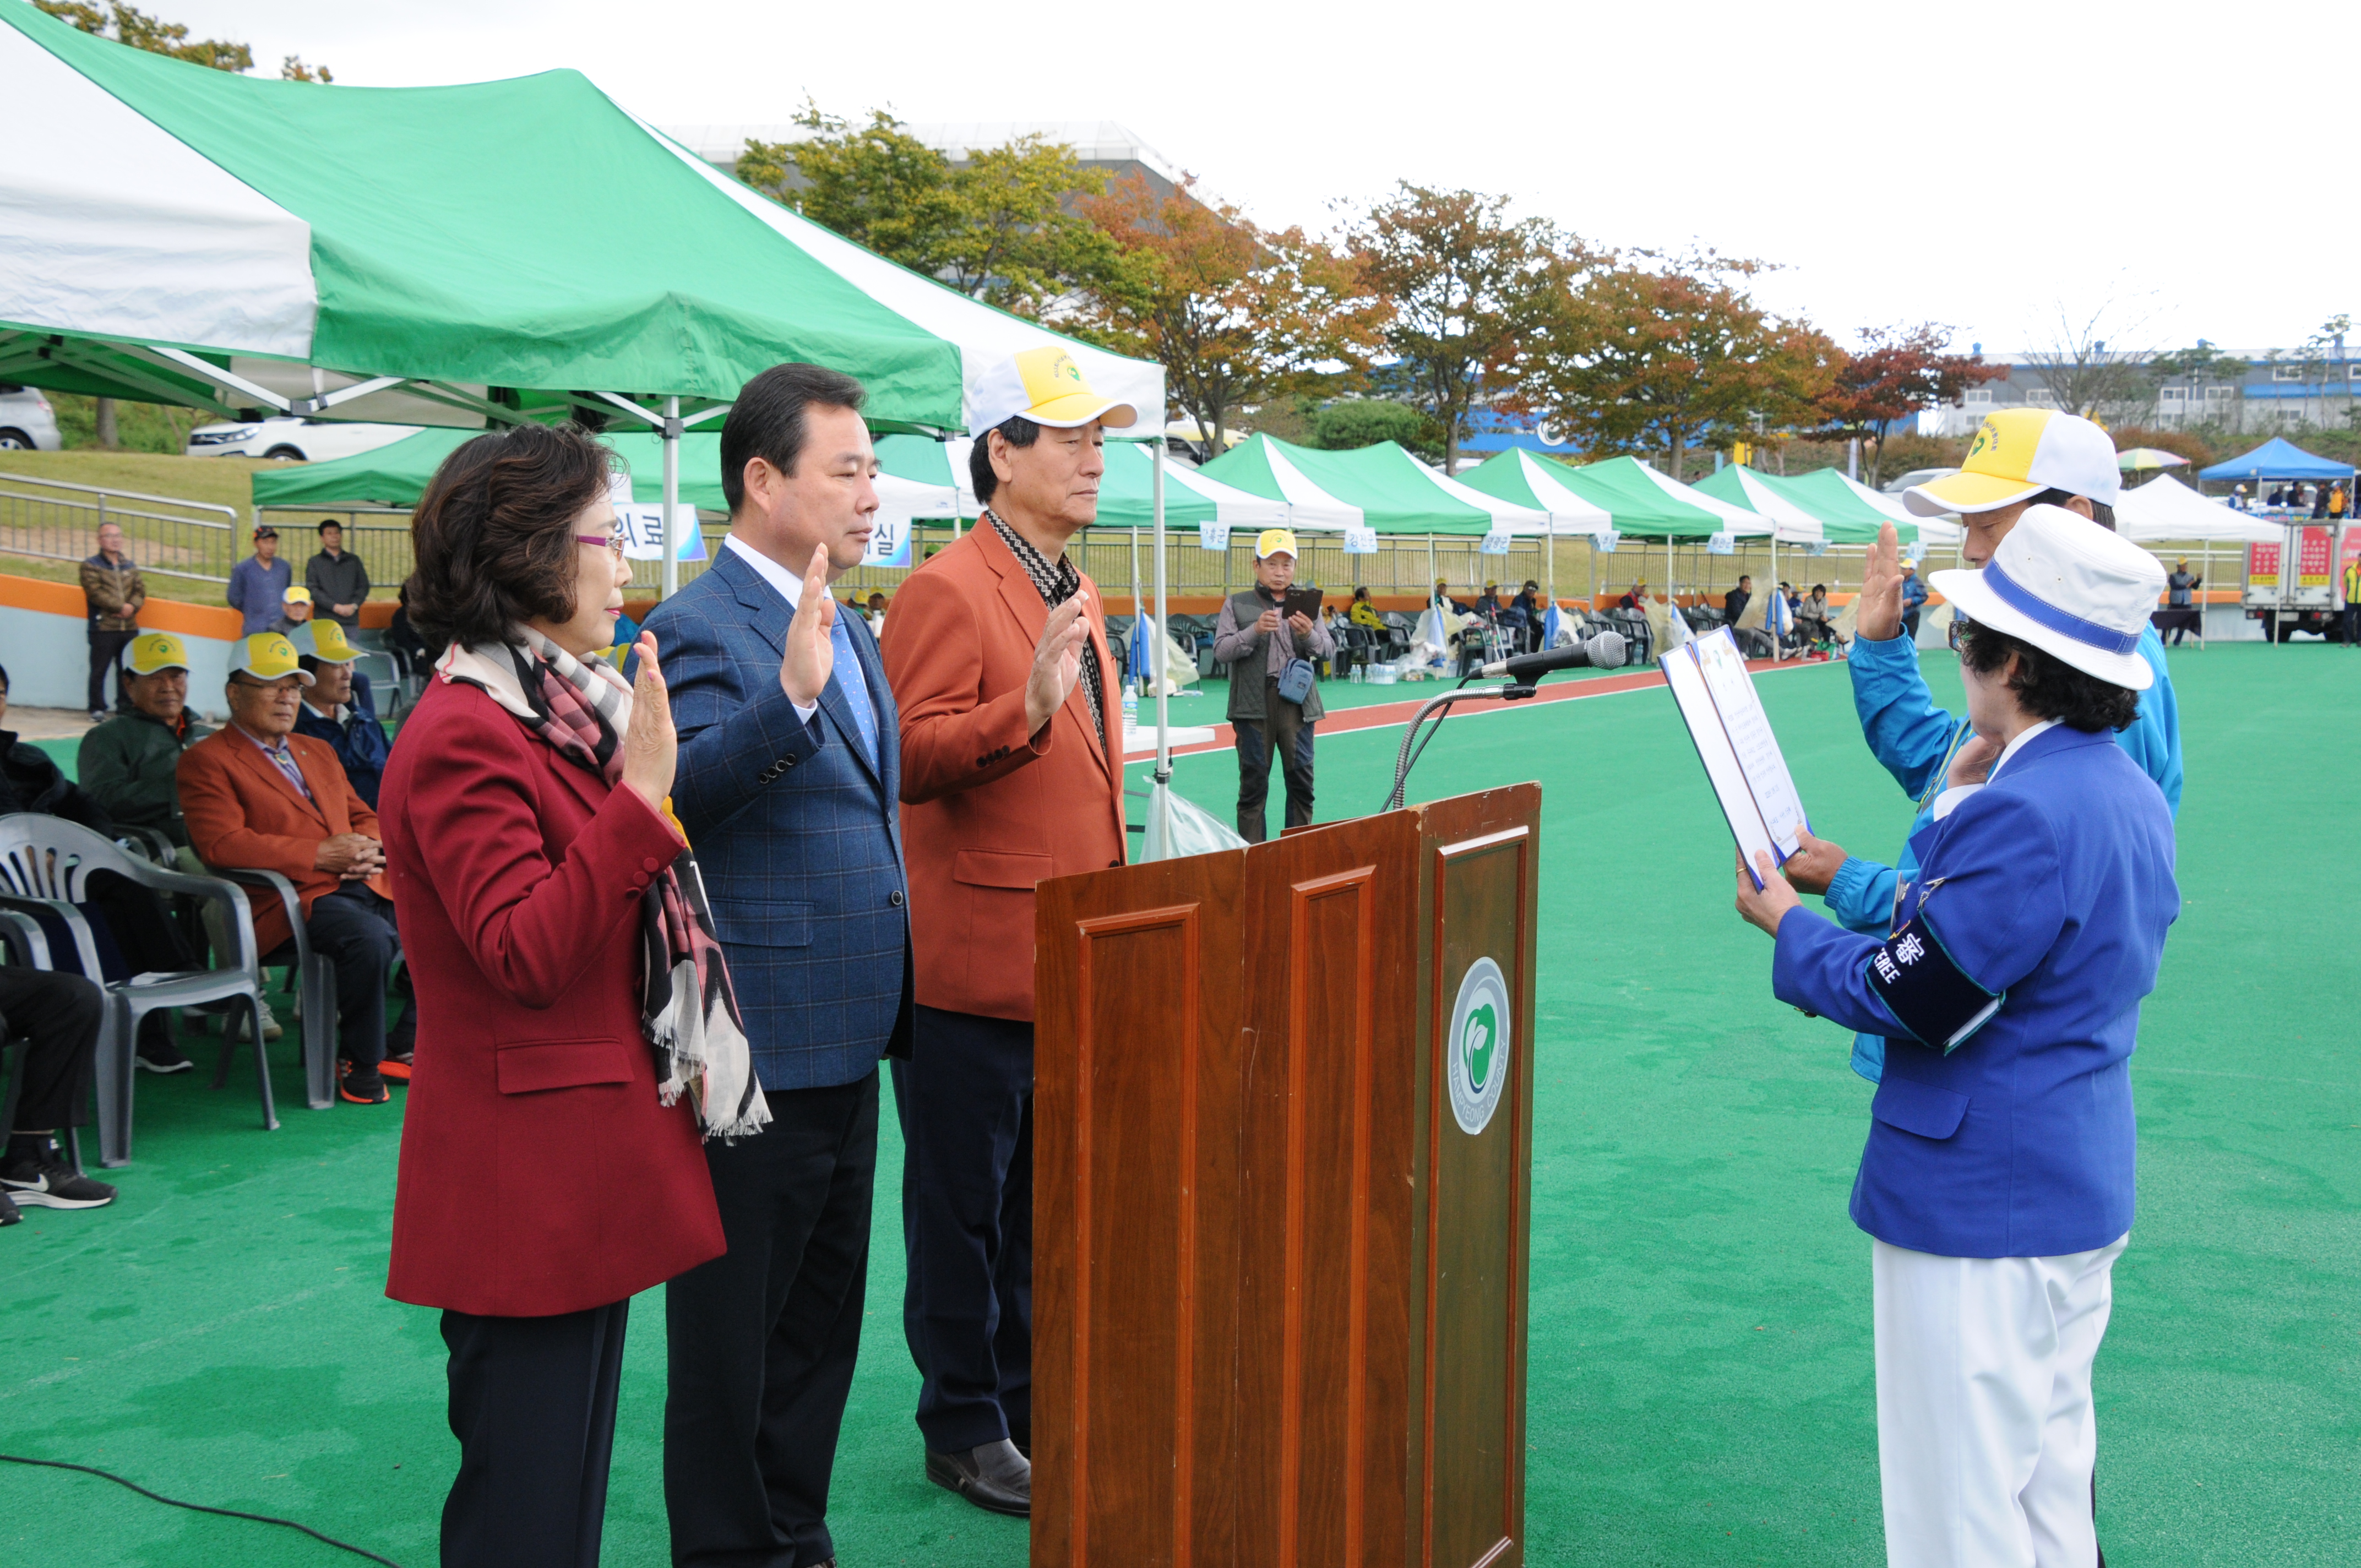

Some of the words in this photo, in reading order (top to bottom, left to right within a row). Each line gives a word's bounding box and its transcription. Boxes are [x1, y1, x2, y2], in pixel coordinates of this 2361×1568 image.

[1350, 533, 1375, 547] 강진군
[1486, 536, 1508, 549] 영광군
[1874, 946, 1901, 984] EREE
[1452, 1061, 1485, 1123] HAMPYEONG
[1487, 1038, 1506, 1107] COUNTY
